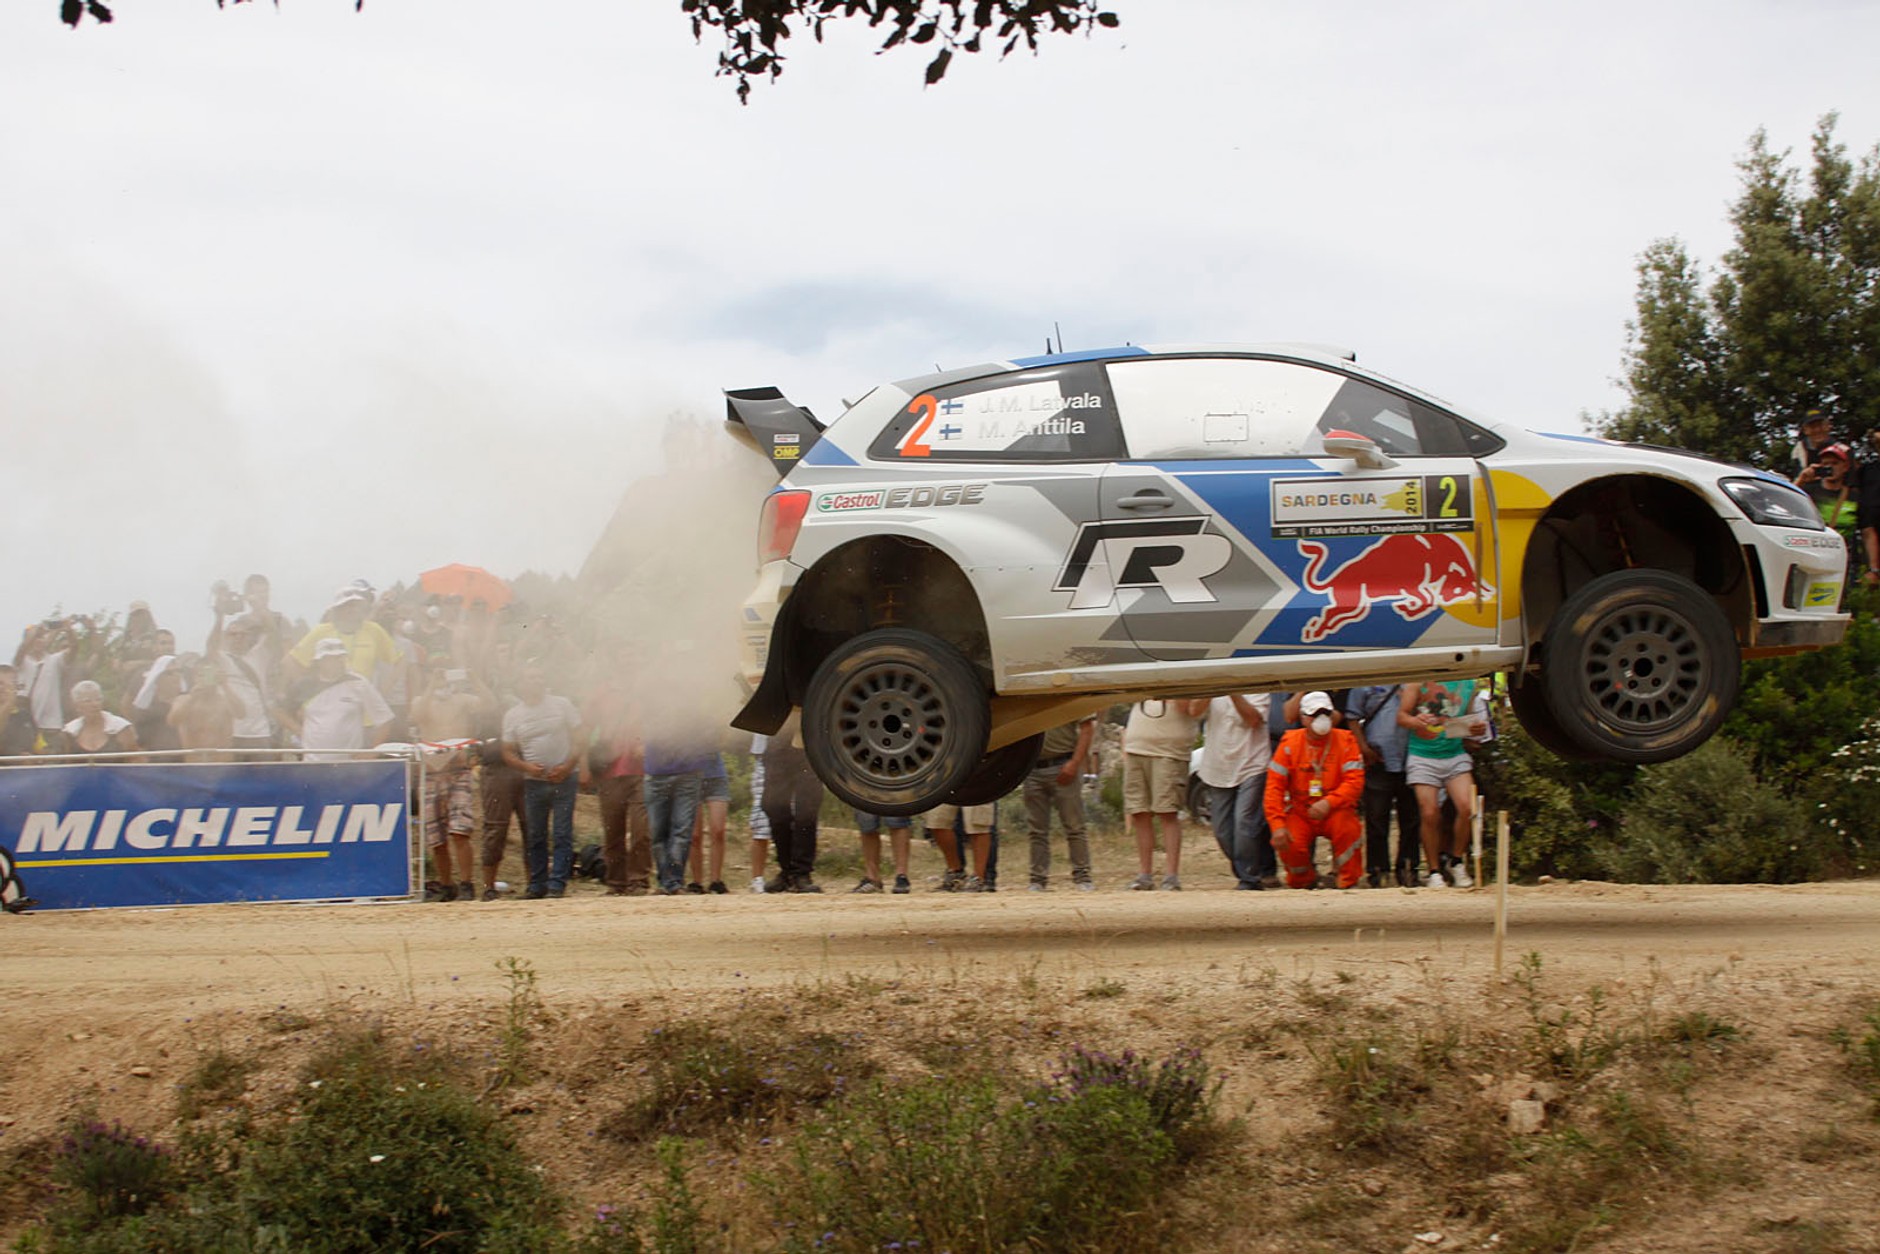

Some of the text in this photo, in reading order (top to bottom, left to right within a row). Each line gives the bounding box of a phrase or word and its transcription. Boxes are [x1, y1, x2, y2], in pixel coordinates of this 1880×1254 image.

[1028, 392, 1102, 412] Latvala
[900, 395, 938, 457] 2
[978, 417, 1086, 439] M. Anttila
[833, 484, 988, 509] Castrol EDGE
[1281, 493, 1377, 507] SARDEGNA
[1405, 481, 1417, 514] 2014
[1439, 476, 1458, 517] 2
[15, 803, 402, 853] MICHELIN
